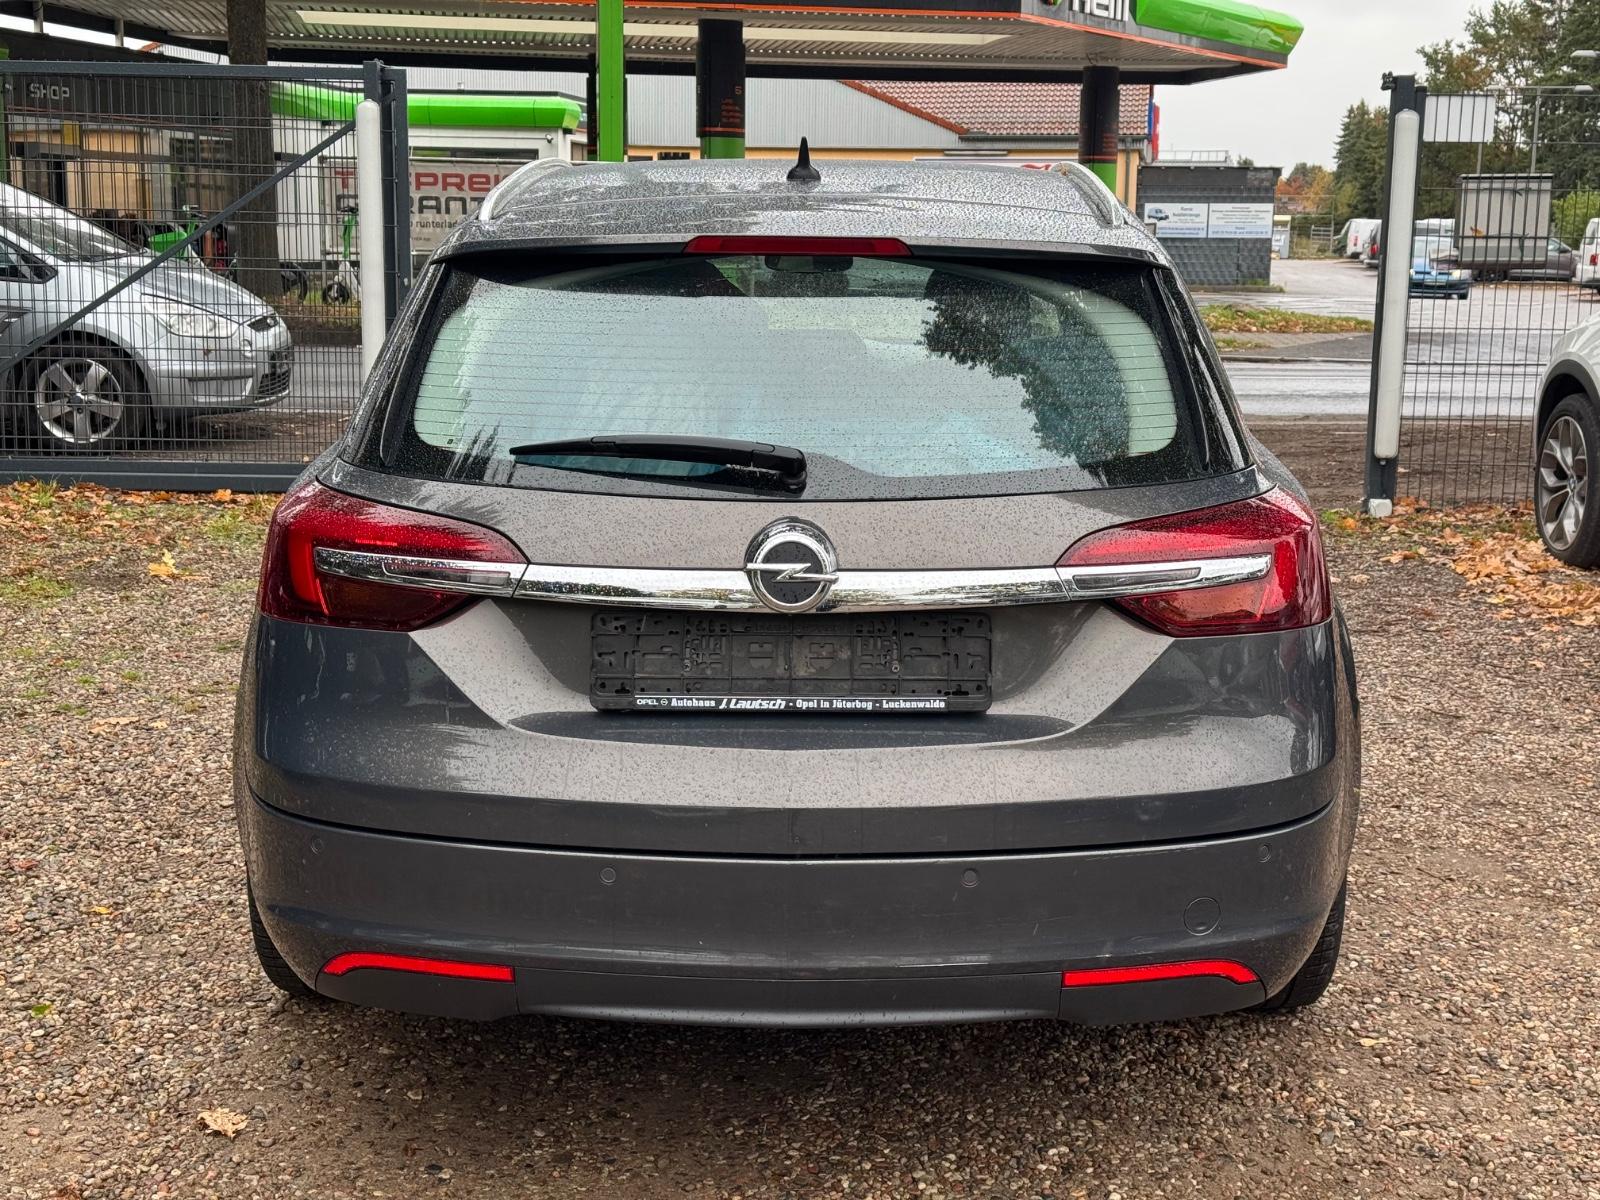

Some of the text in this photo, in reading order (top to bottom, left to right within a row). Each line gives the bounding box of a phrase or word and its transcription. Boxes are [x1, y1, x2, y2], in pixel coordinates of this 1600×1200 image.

[30, 83, 70, 99] SHOP
[415, 219, 459, 229] runterlad
[671, 698, 716, 707] Autohaus
[729, 698, 786, 709] Lautsch
[796, 699, 817, 709] Opel
[832, 699, 873, 710] Jüterbog
[882, 700, 945, 708] Luckenwalde
